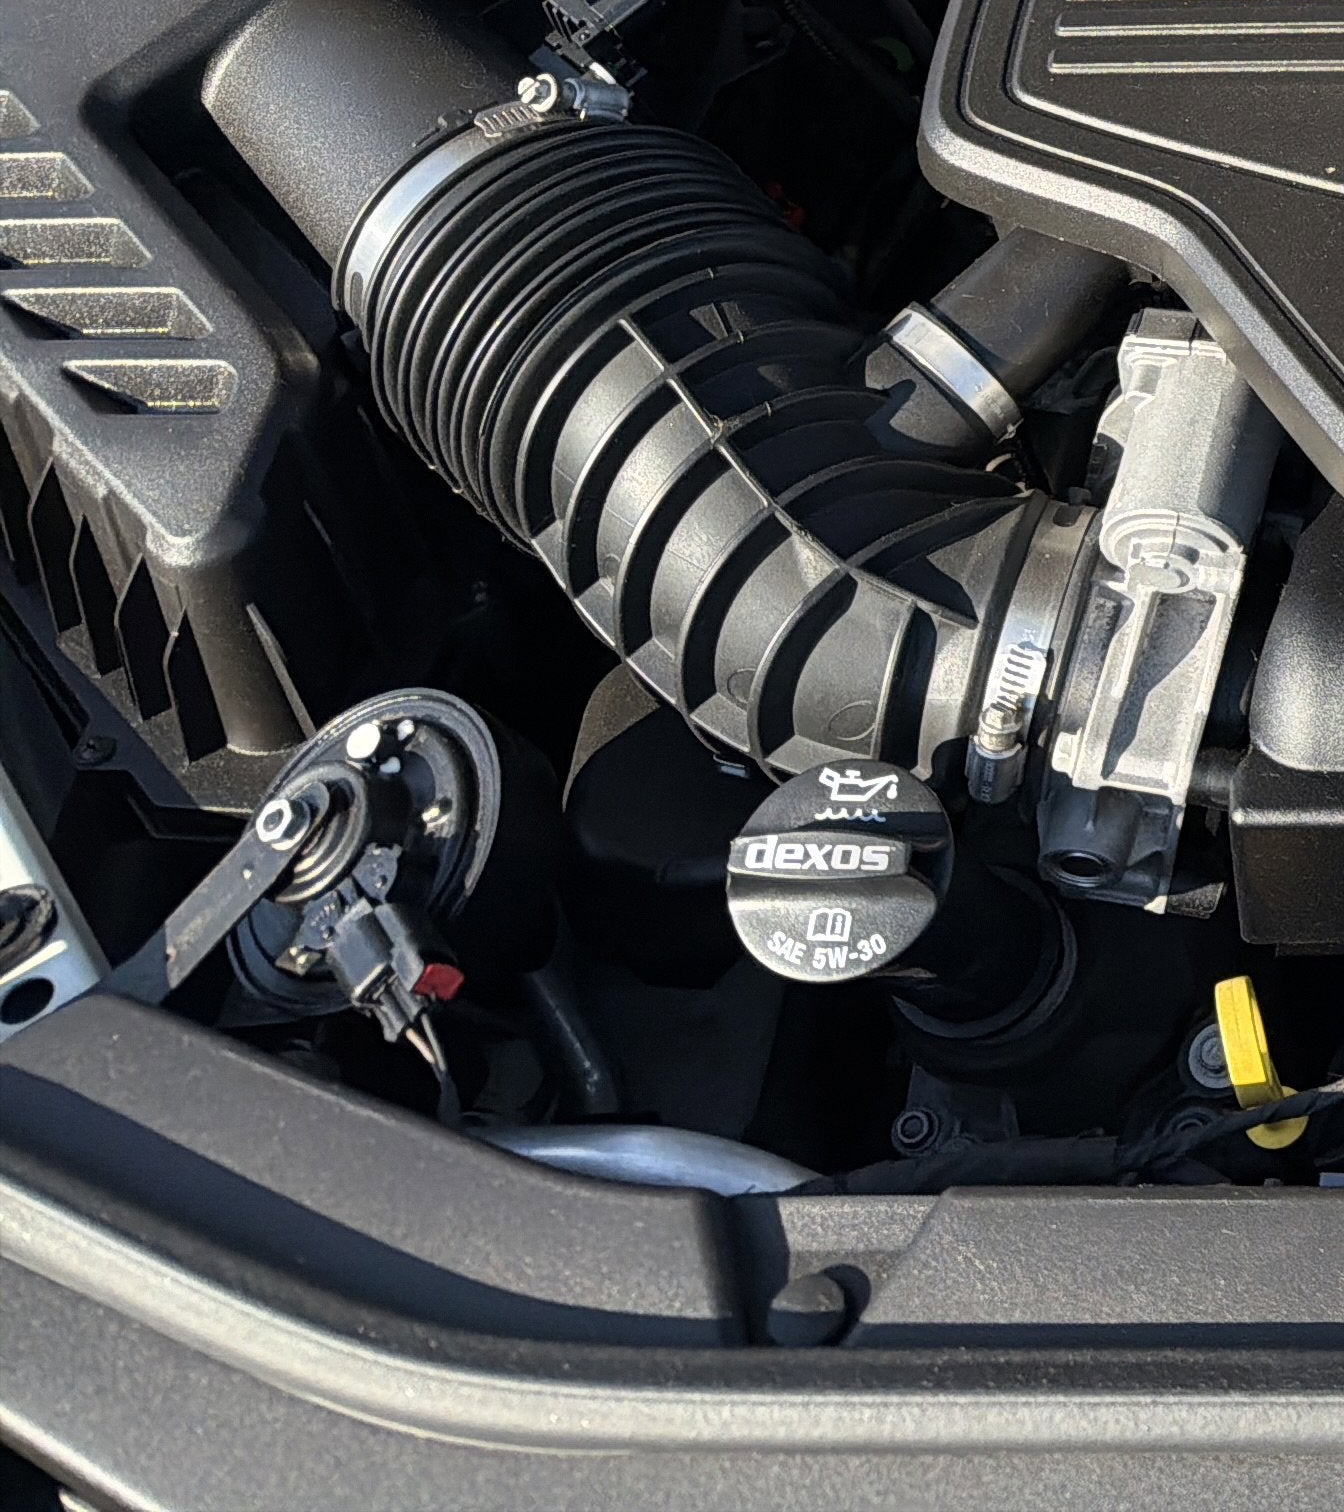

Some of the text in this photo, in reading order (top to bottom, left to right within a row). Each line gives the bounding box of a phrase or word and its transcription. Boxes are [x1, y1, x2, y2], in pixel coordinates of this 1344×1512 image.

[744, 834, 890, 872] dexos
[767, 931, 888, 970] SAE 5W-30
